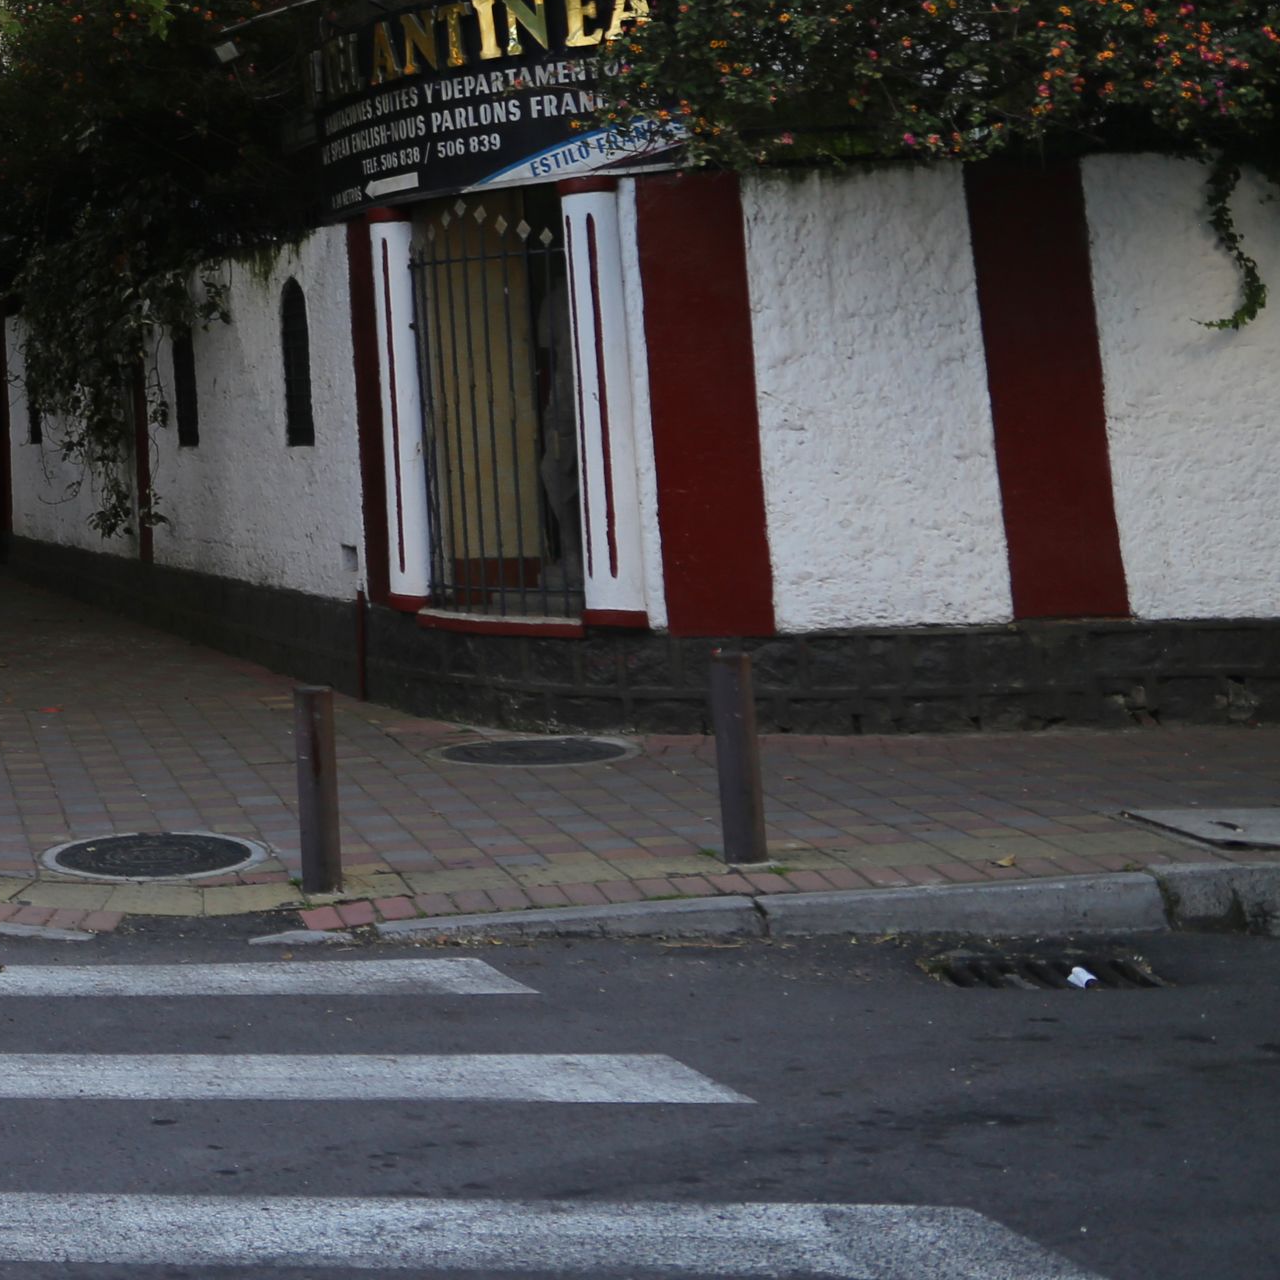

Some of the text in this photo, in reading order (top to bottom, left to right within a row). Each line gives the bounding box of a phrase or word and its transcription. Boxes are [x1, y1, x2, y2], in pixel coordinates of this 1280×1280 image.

[376, 86, 419, 116] SUITES
[441, 56, 627, 102] DEPARTAMENTO
[331, 136, 351, 163] SPEAK
[431, 99, 521, 134] PARLONS
[381, 152, 398, 171] 506
[400, 146, 420, 167] 838
[437, 137, 465, 159] 506
[469, 132, 501, 154] 839
[530, 141, 589, 177] ESTILO
